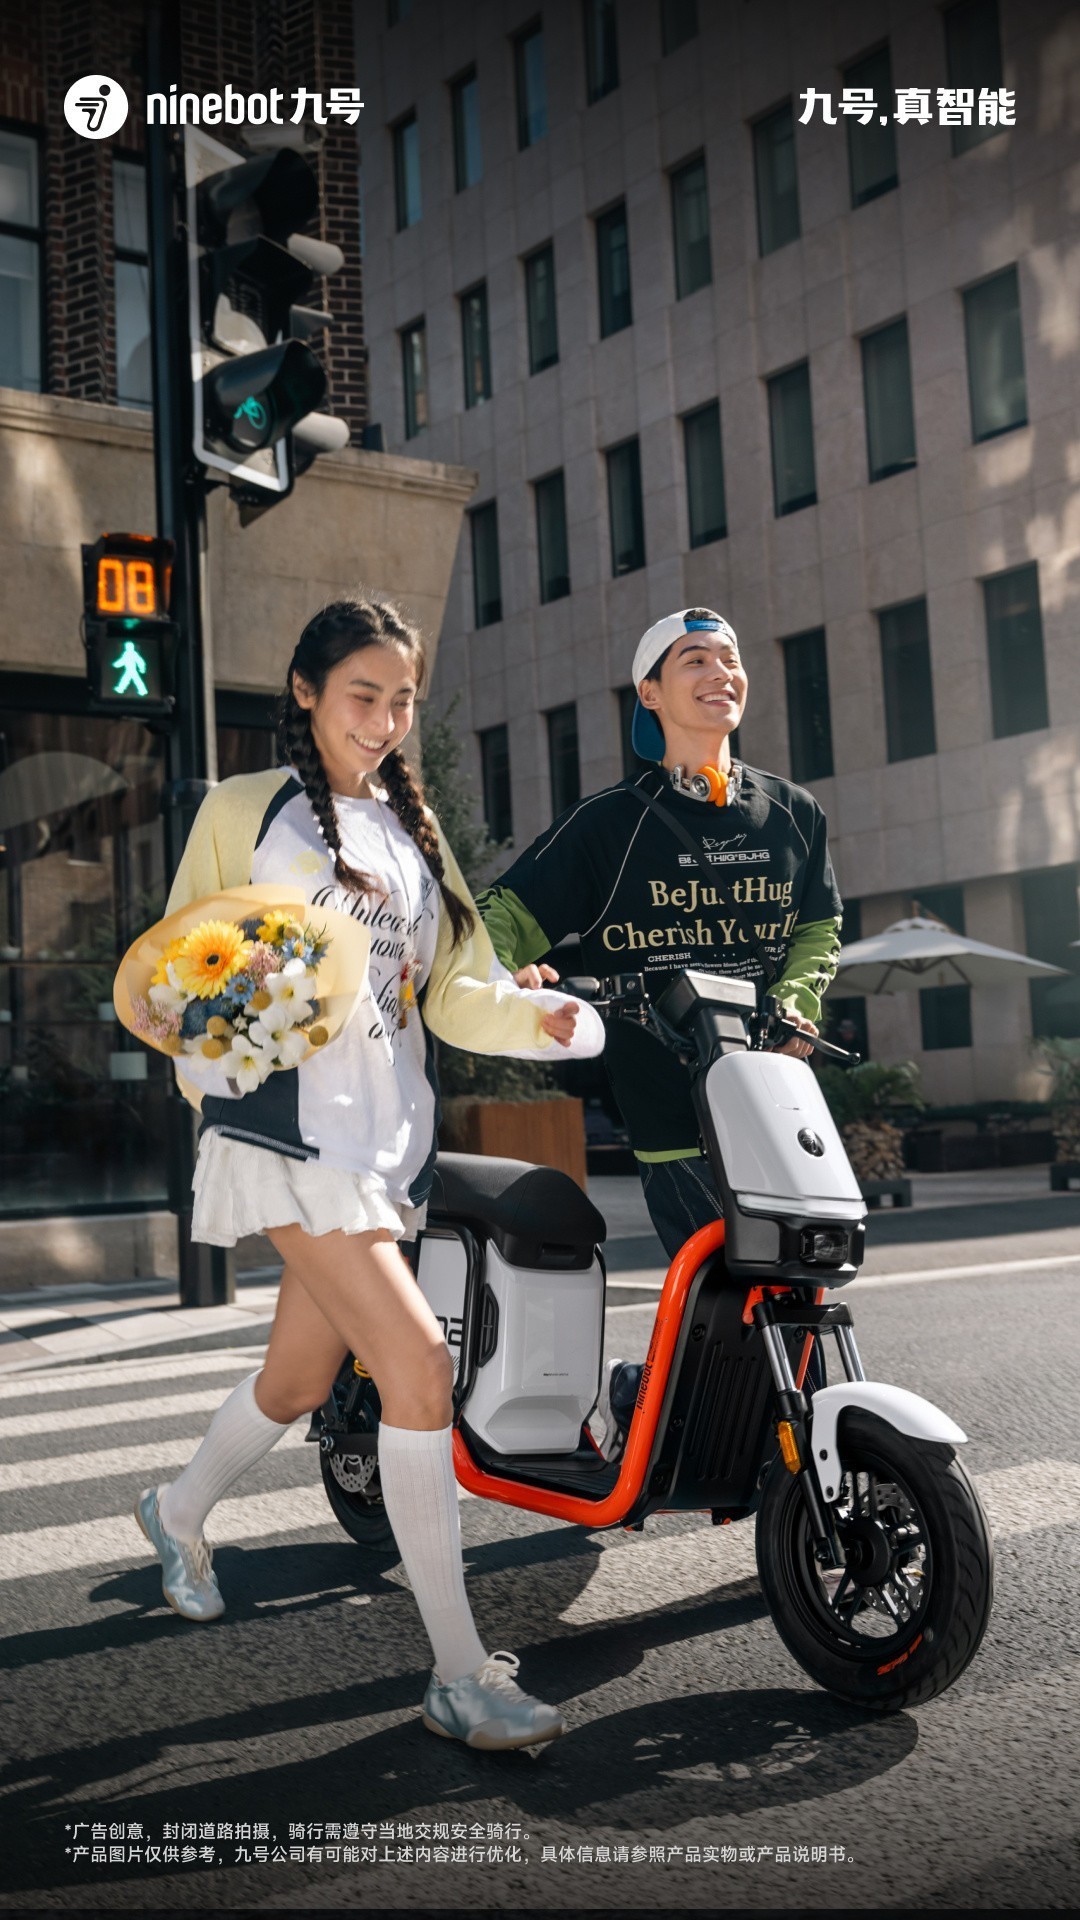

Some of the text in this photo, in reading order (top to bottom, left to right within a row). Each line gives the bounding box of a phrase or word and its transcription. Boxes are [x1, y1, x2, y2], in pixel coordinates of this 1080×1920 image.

[98, 558, 155, 613] 08
[648, 876, 793, 914] BeJutHug
[602, 919, 714, 951] Cherish
[647, 952, 691, 963] CHERISH
